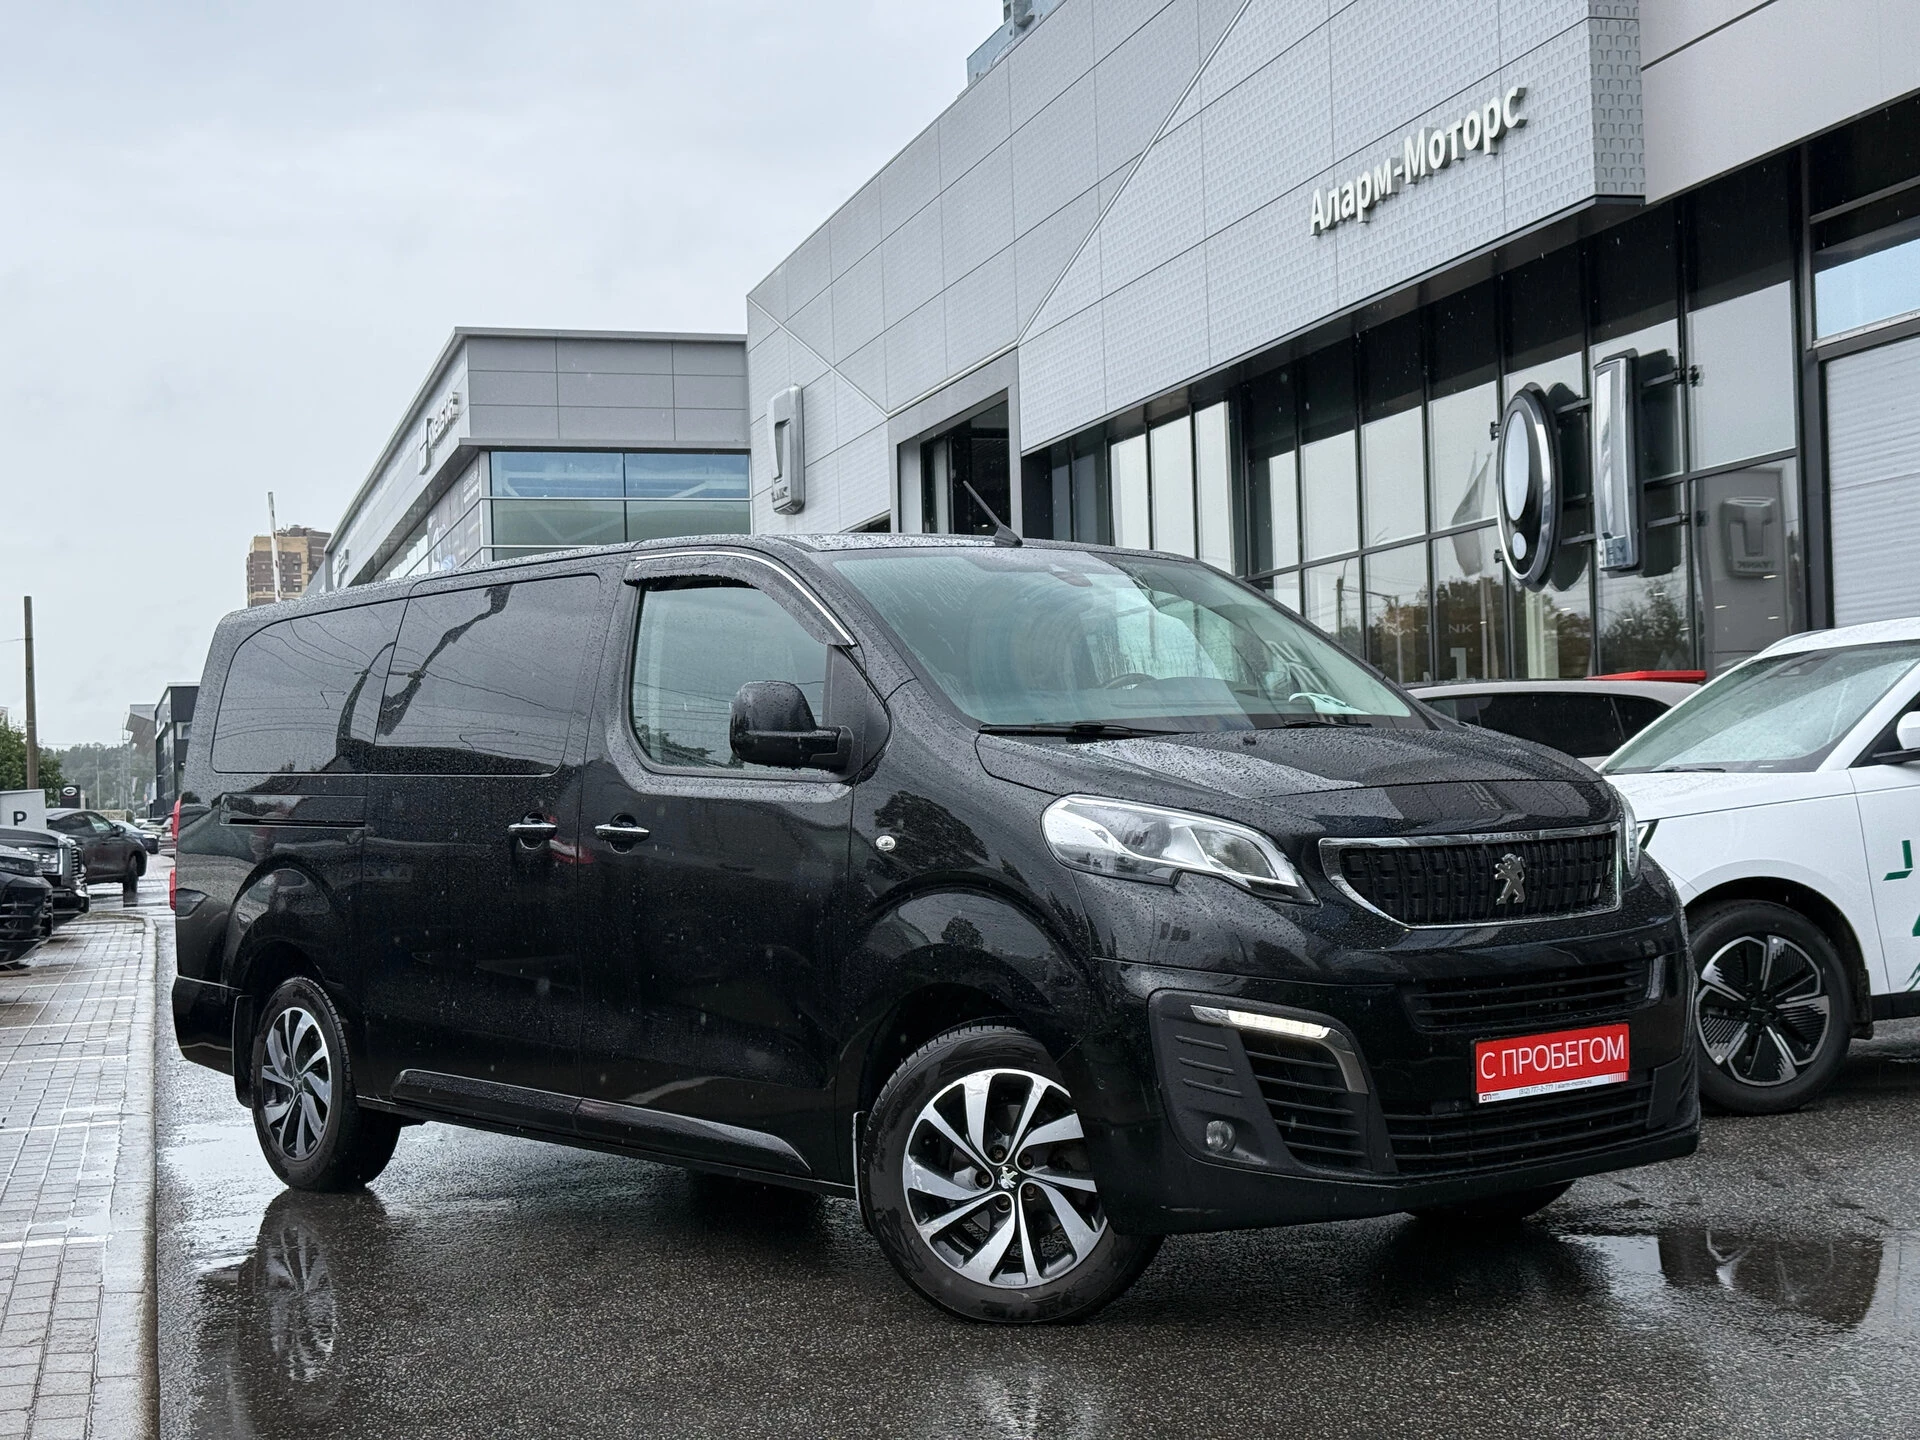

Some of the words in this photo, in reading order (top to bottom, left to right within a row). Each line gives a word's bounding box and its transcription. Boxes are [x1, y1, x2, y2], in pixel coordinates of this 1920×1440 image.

[1310, 86, 1528, 236] Аларм-Моторс
[1422, 624, 1474, 634] TNK
[13, 811, 28, 826] P
[1480, 1052, 1497, 1080] С
[1502, 1034, 1625, 1077] ПРОБЕГОМ
